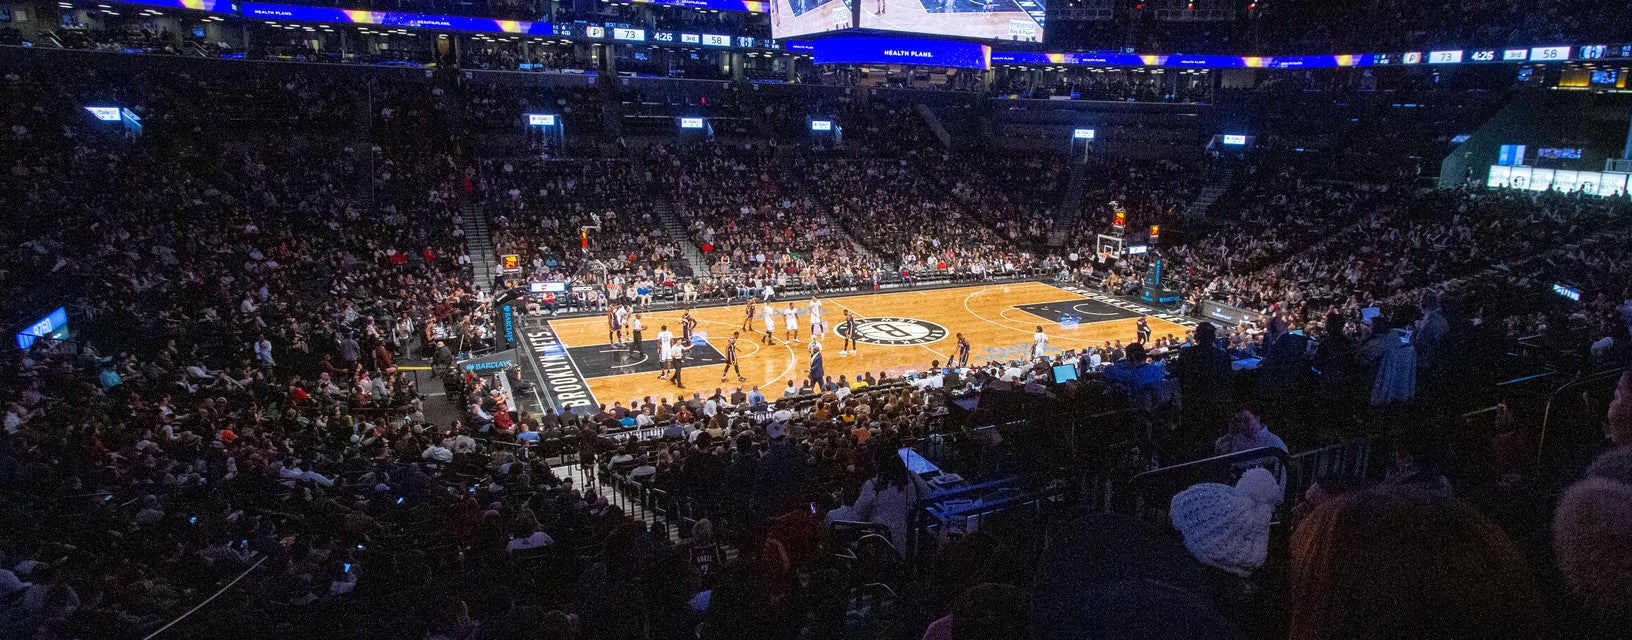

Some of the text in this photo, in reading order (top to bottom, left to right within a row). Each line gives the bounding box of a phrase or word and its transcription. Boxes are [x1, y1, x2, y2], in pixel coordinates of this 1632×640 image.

[624, 30, 636, 39] 73
[653, 32, 673, 42] 4:26
[711, 36, 722, 45] 58
[1440, 53, 1452, 62] 73
[1471, 51, 1494, 61] 4:26
[1542, 49, 1557, 59] 58
[504, 312, 514, 342] BARCLAYS
[527, 331, 592, 408] BROOKLYN NETS
